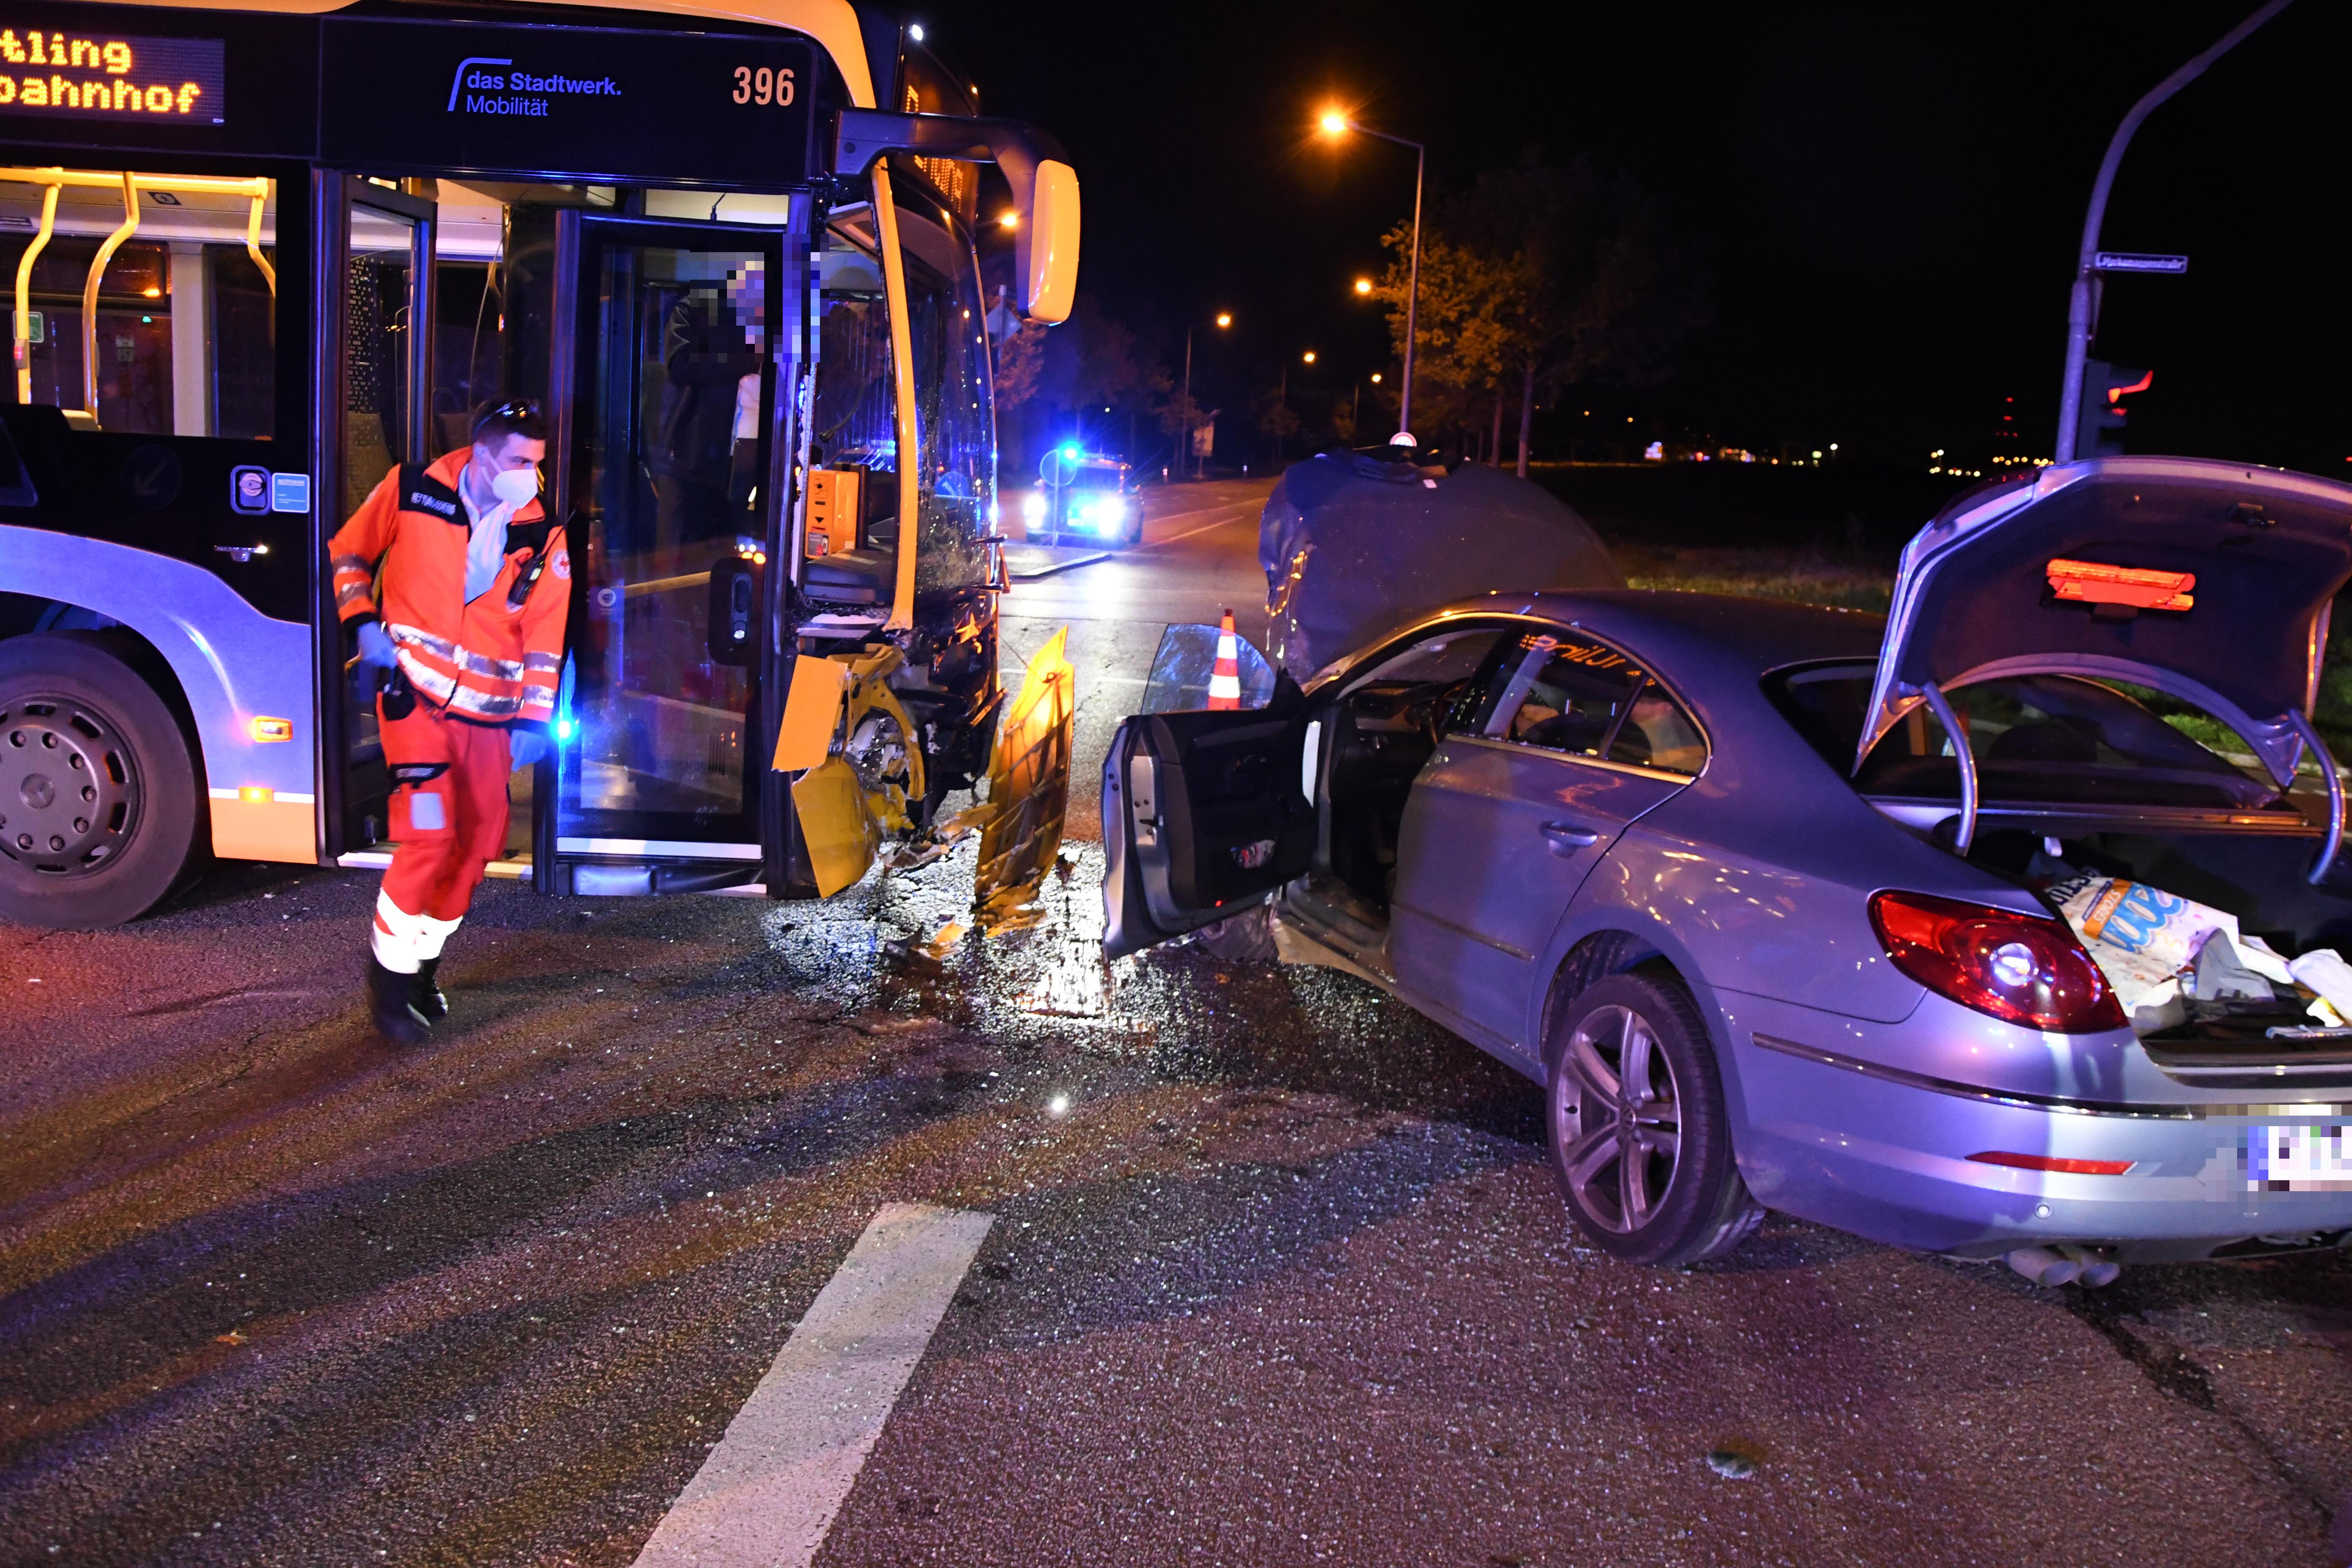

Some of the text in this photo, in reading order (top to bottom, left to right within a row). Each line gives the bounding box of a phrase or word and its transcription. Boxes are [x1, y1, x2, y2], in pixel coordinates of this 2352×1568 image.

[467, 71, 622, 95] das Stadtwerk.
[732, 66, 795, 106] 396
[466, 95, 549, 116] Mobilität
[2092, 888, 2121, 924] STORES
